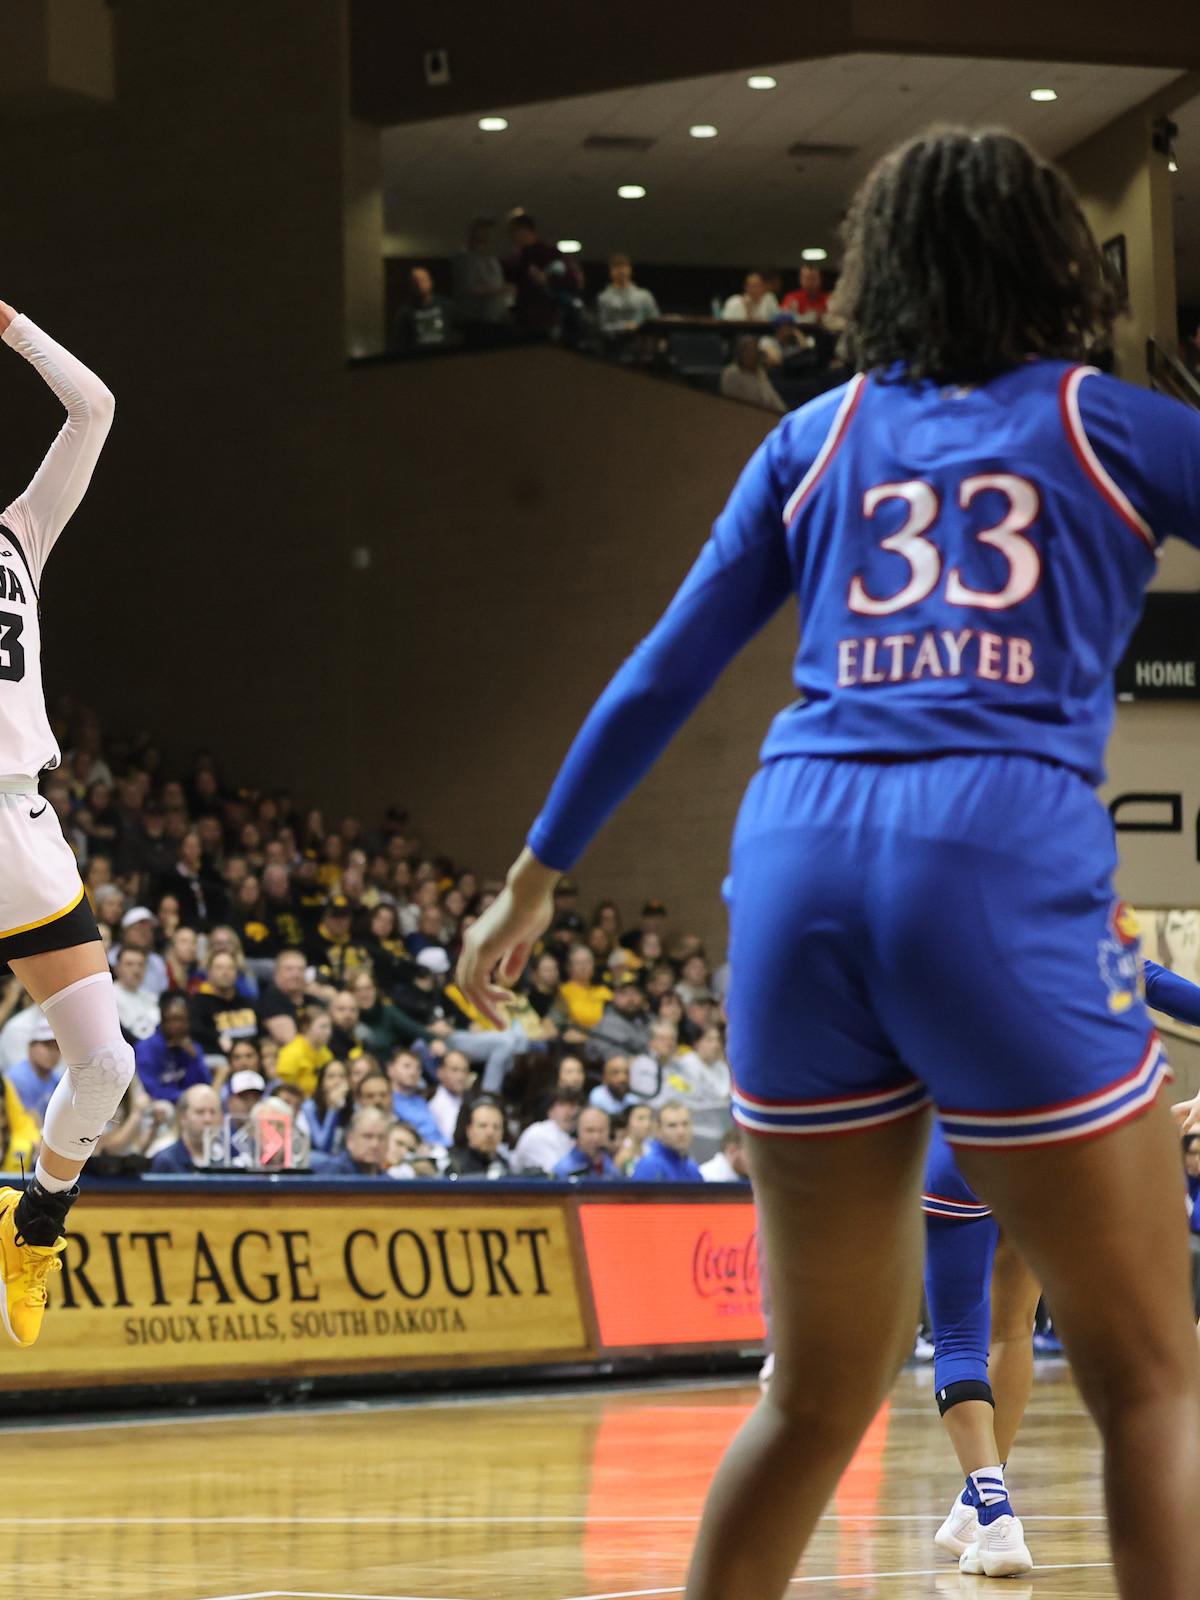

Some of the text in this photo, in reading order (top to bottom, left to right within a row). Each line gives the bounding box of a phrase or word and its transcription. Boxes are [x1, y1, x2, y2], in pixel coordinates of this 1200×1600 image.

[847, 472, 1043, 618] 33
[836, 627, 1036, 688] ELTAYEB
[1135, 660, 1196, 687] HOME
[343, 1228, 552, 1301] COURT
[123, 1307, 467, 1346] SIOUX FALLS, SOUTH DAKOTA
